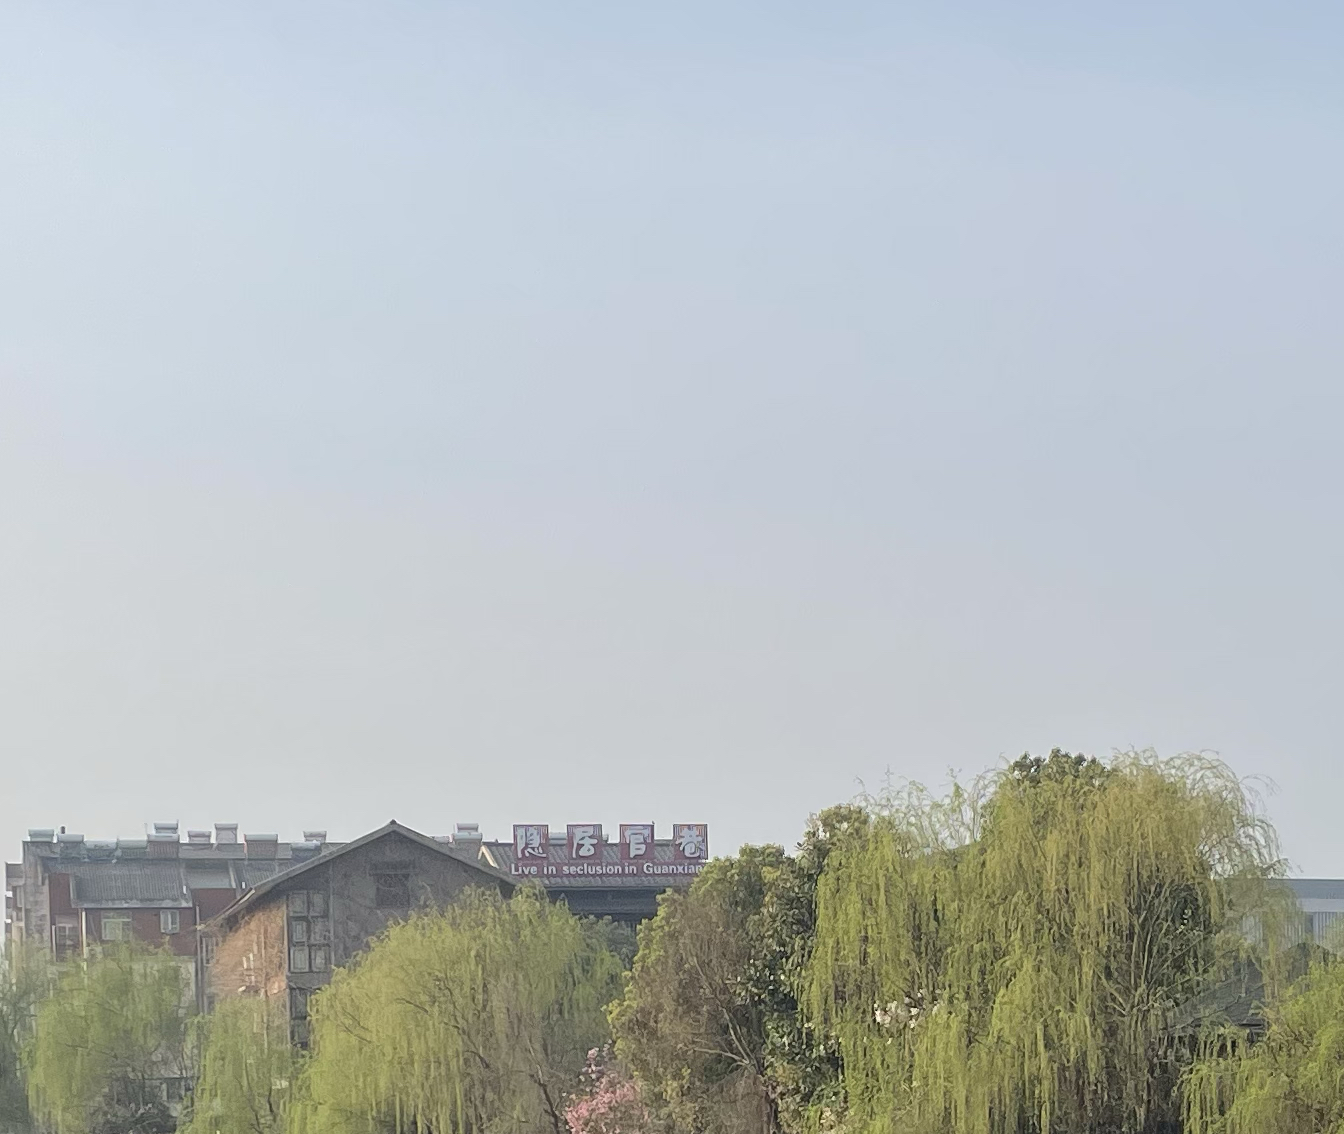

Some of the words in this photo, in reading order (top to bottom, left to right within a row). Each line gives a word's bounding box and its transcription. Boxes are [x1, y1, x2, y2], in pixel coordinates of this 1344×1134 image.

[517, 825, 706, 859] 隐居官巷
[511, 863, 538, 875] Live
[543, 863, 556, 875] in
[562, 863, 622, 875] seclusion
[625, 863, 637, 875] in
[643, 862, 703, 874] Guanxian
